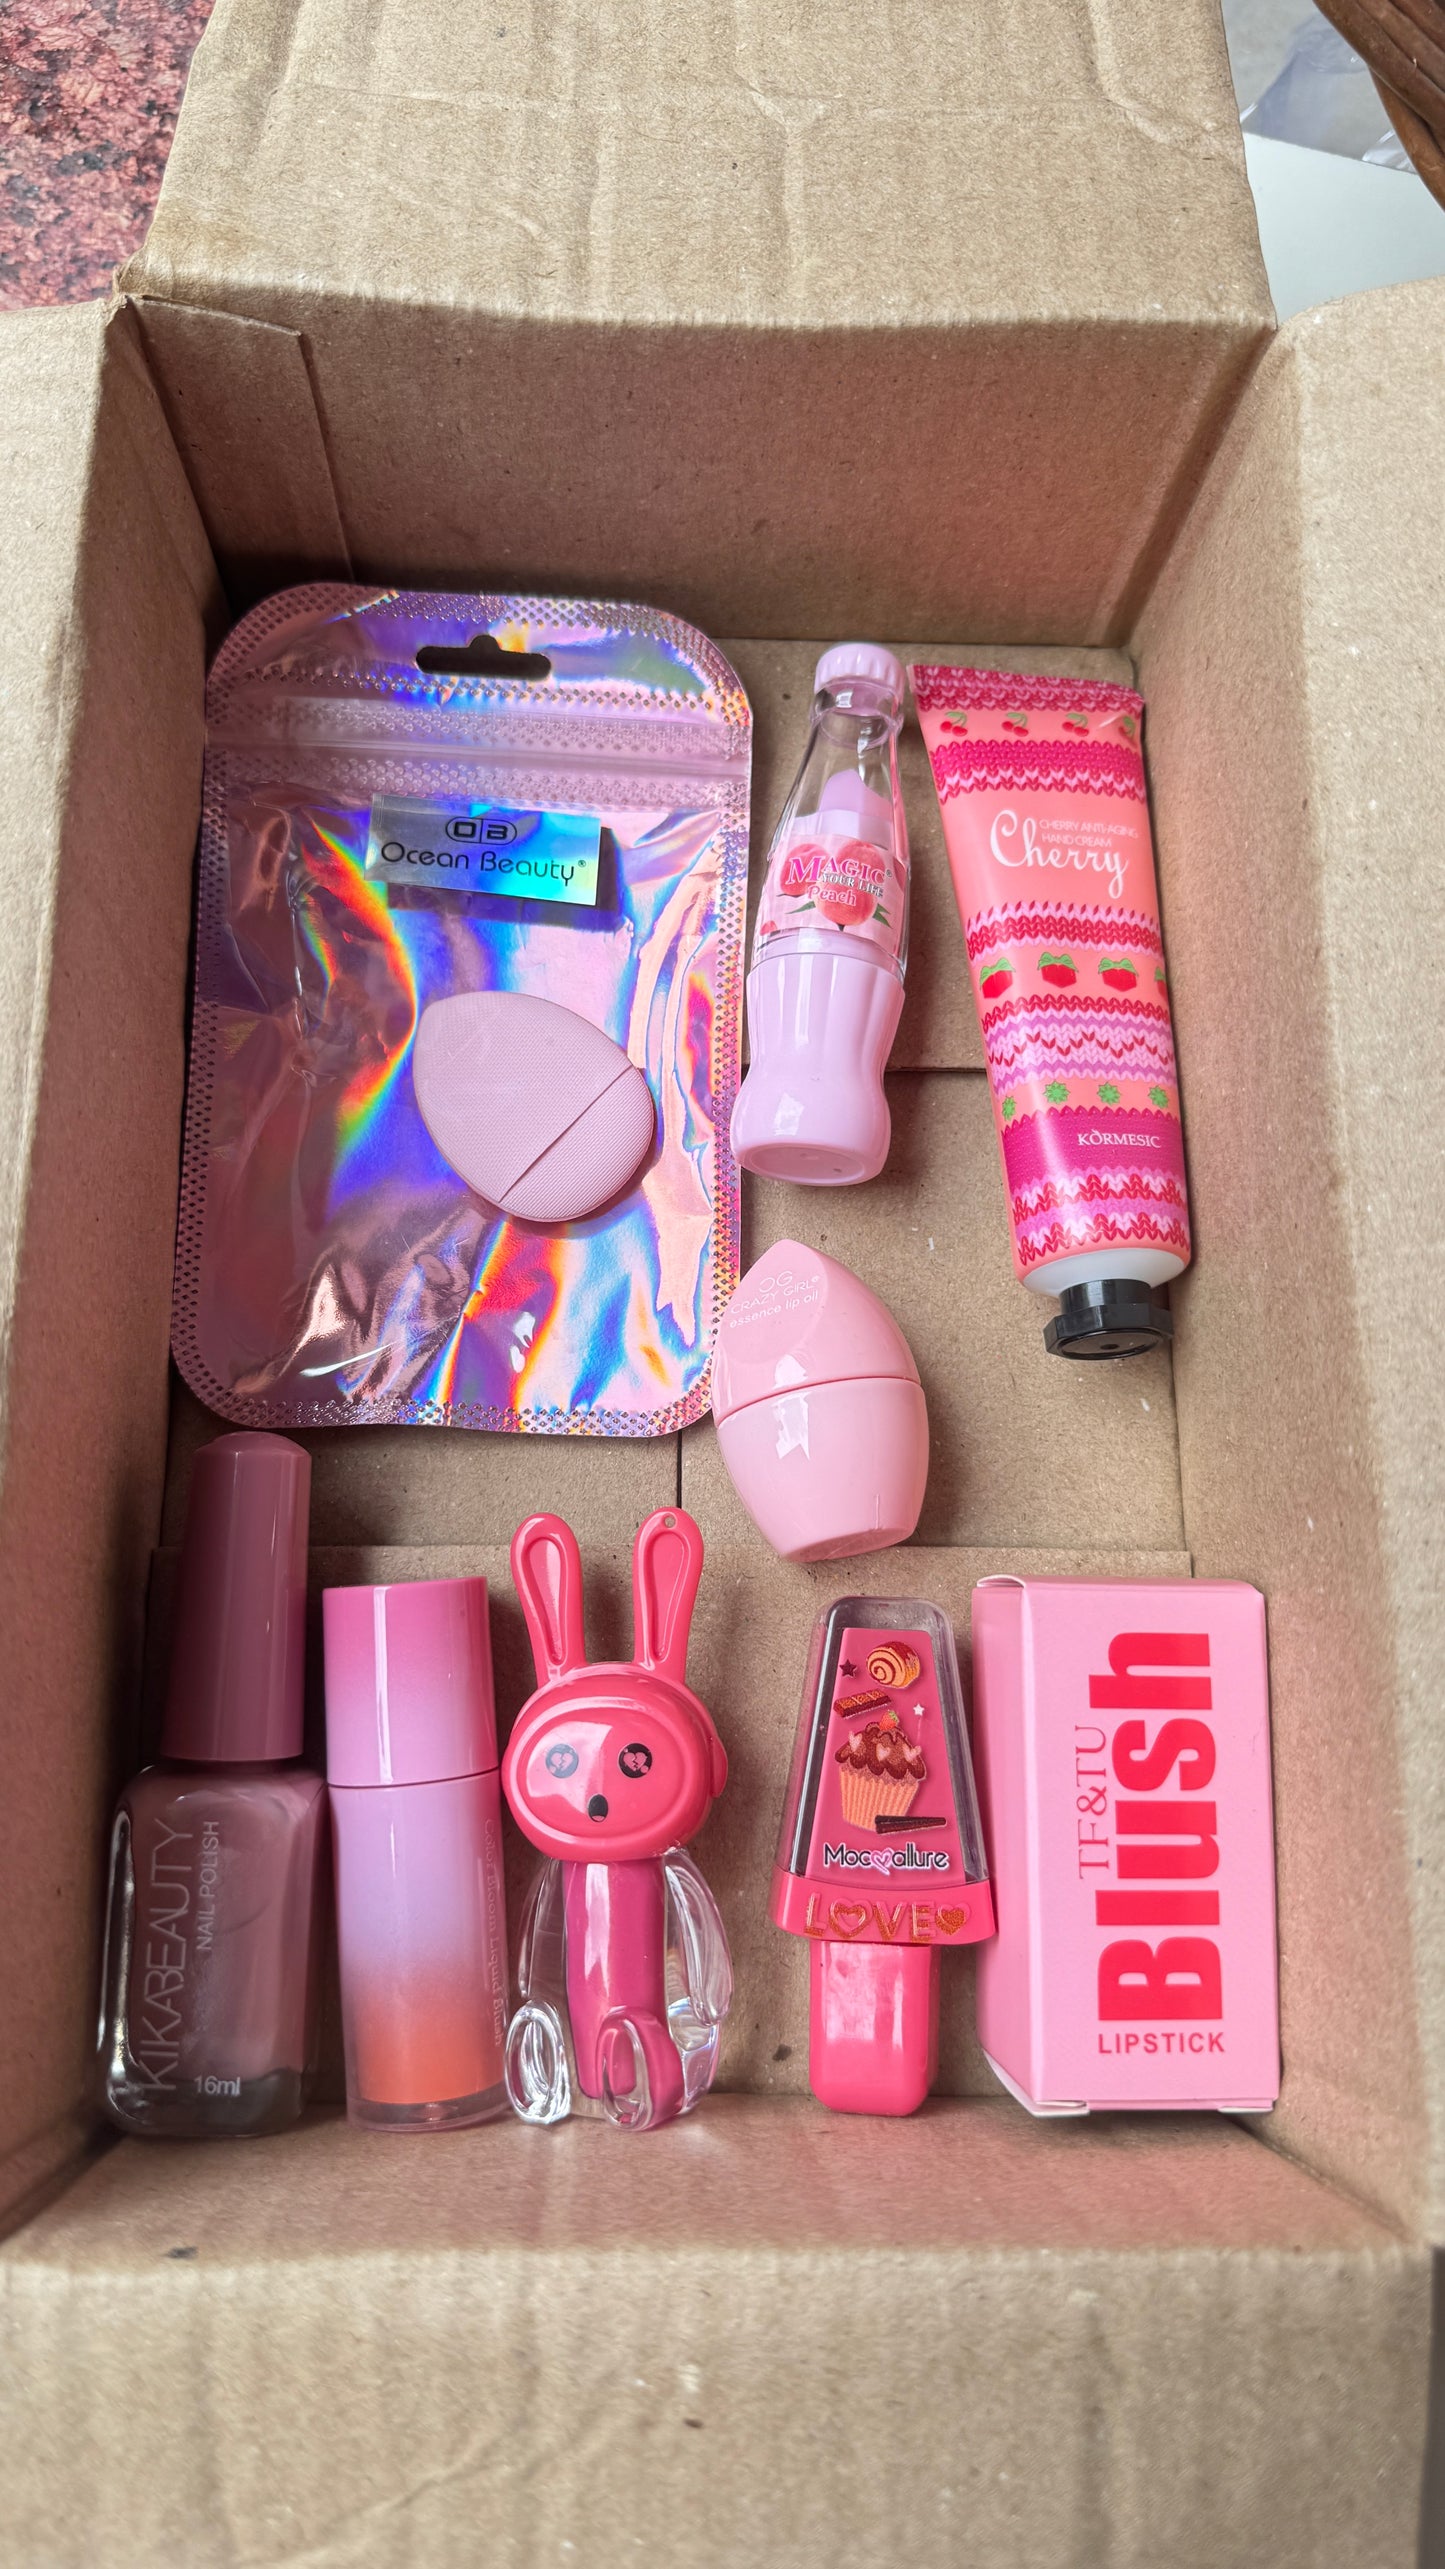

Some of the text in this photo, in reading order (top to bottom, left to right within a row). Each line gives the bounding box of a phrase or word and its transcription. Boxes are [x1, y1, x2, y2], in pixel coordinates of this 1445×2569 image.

[1039, 818, 1139, 839] CHERRY ANTI-AGING
[1041, 832, 1112, 848] HAND CREAM
[381, 841, 575, 887] Ocean Beauty
[784, 855, 886, 886] MAGIC
[989, 809, 1130, 900] Cherry
[806, 884, 858, 907] Peach
[821, 872, 856, 888] YOUR
[729, 1289, 819, 1328] essence lip oil
[730, 1279, 816, 1314] CRAZY GIRL
[1074, 1724, 1110, 1880] TF&TU
[1088, 1632, 1223, 2021] Blush
[196, 1820, 220, 1951] NAIL POLISH
[486, 1875, 498, 1933] Bloom
[138, 1817, 194, 2092] KIKABEAUTY
[488, 1937, 503, 1995] Liquid
[492, 1998, 505, 2048] Blush
[1097, 2031, 1226, 2055] LIPSTICK
[194, 2074, 242, 2097] 16ml
